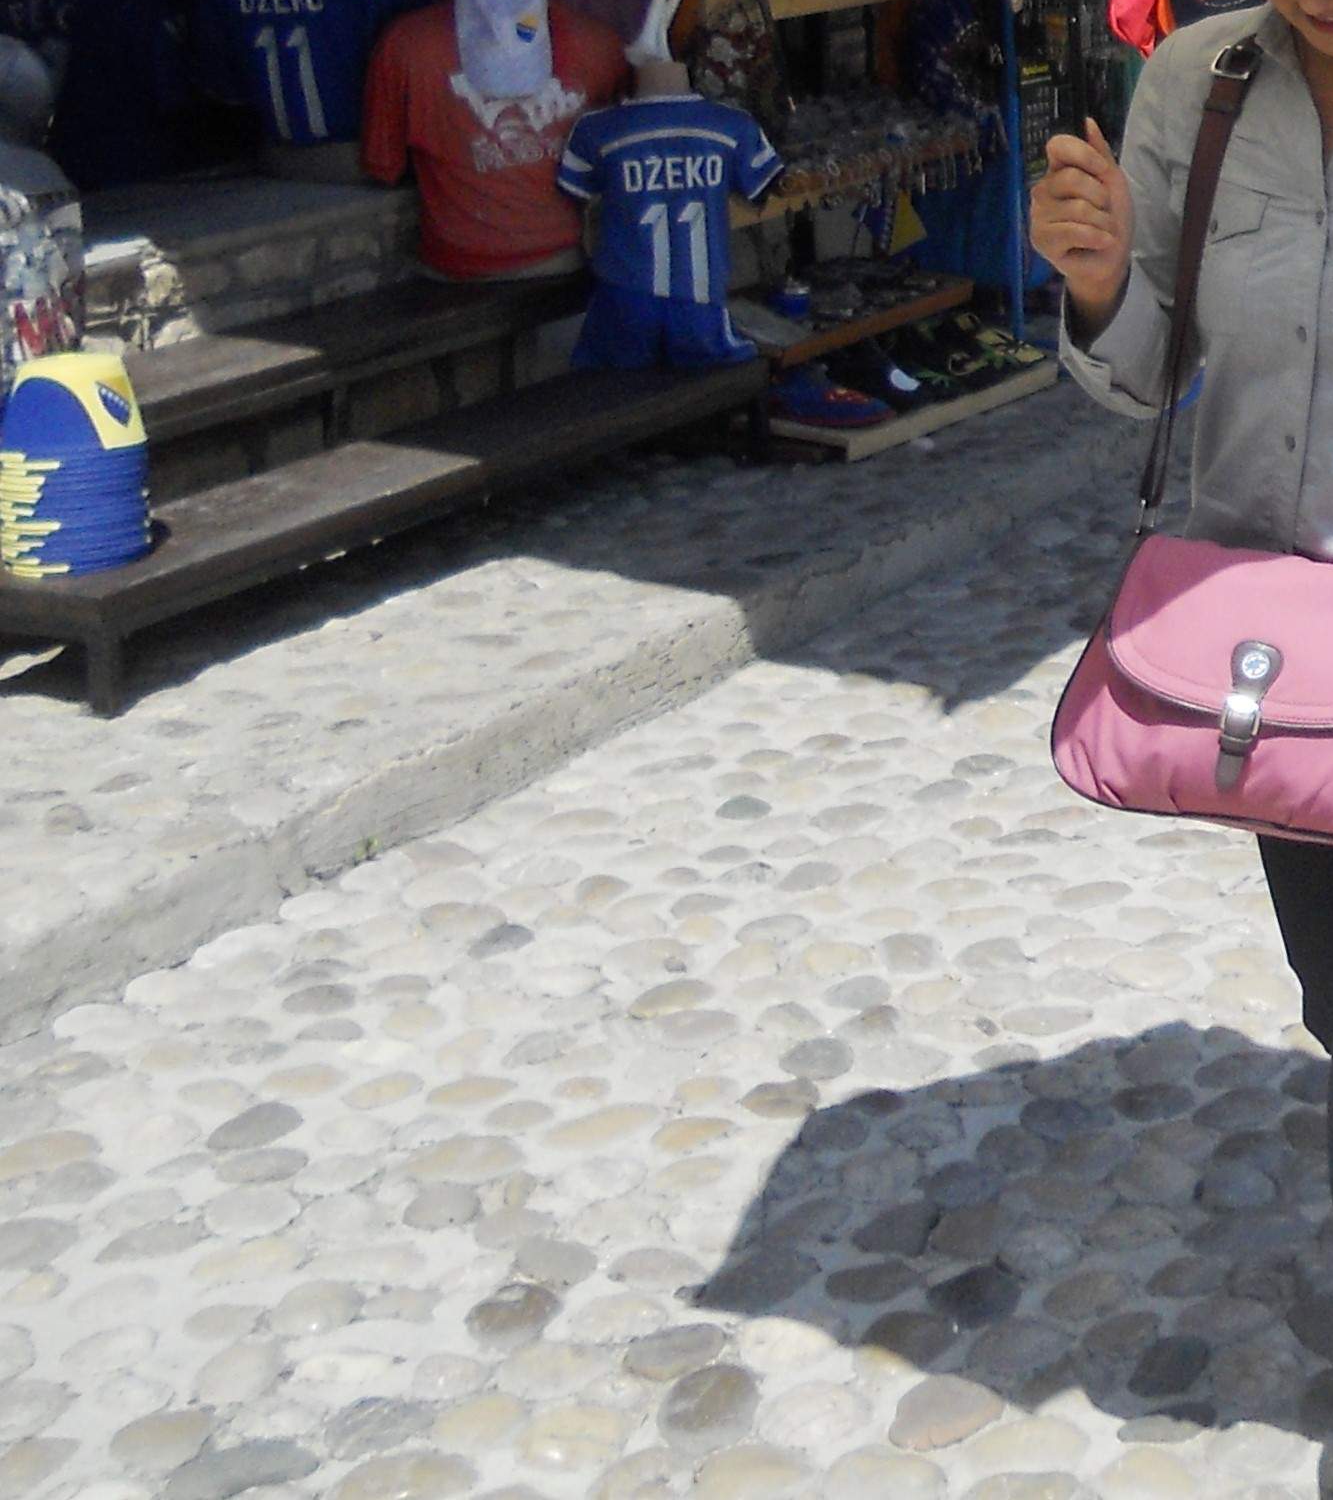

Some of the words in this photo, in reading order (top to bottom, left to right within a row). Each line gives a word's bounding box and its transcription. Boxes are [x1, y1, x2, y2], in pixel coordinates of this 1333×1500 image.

[255, 25, 329, 140] 11
[623, 154, 724, 193] DŽEKO
[640, 201, 711, 304] 11
